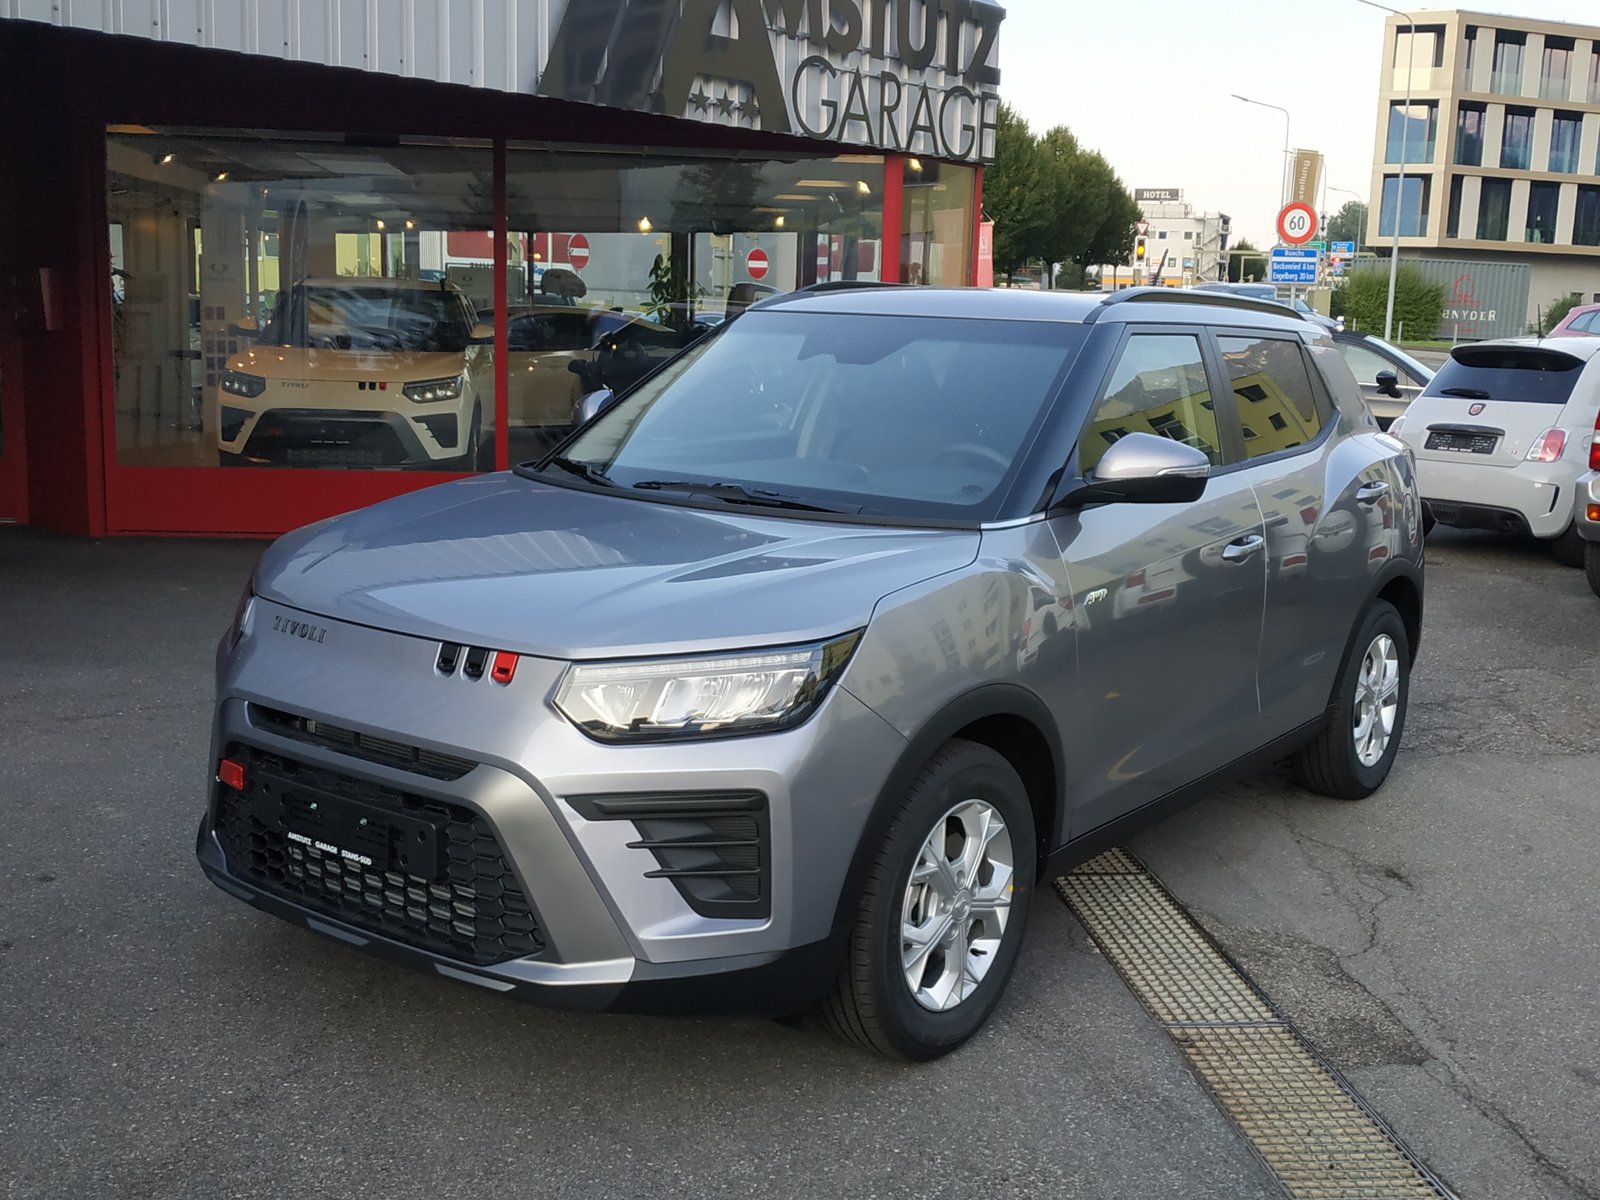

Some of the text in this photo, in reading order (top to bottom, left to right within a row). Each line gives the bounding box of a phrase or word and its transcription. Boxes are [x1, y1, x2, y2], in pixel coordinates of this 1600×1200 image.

[792, 55, 1000, 163] GARAGE
[1143, 190, 1171, 199] HOTEL
[1289, 215, 1305, 231] 60
[1273, 262, 1301, 270] Beckenried
[1273, 272, 1314, 281] Engelberg 20 km
[273, 615, 327, 644] TIVOLI
[287, 831, 312, 846] AMSTUTZ
[314, 840, 338, 855] GARAGE
